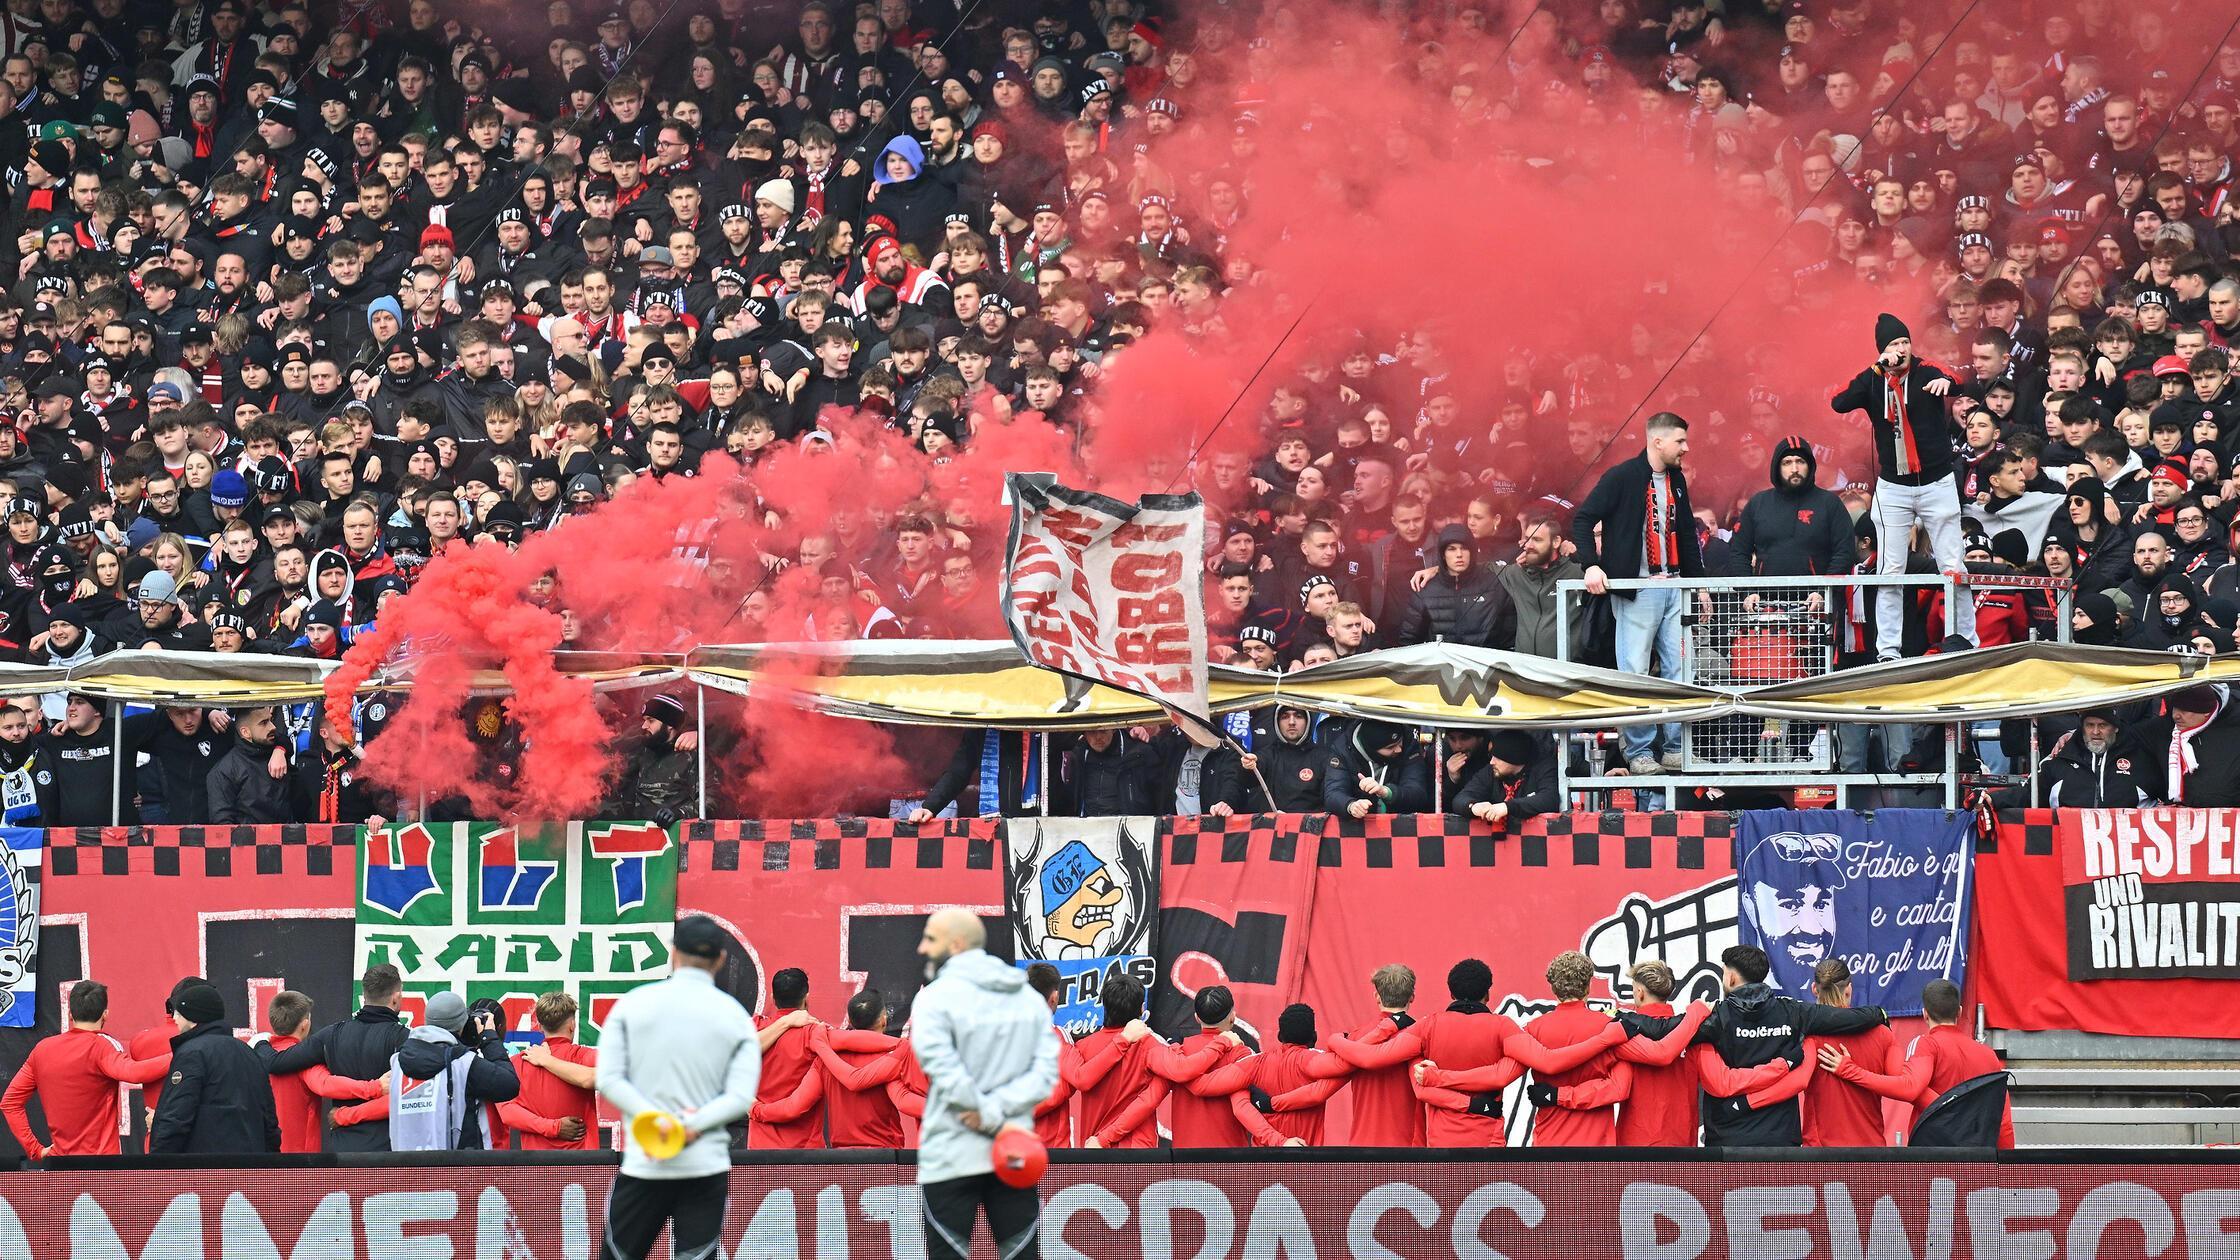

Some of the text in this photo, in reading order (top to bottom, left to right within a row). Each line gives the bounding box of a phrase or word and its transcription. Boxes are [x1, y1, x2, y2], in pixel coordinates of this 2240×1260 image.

[1845, 840, 1919, 879] Fabio
[1923, 847, 1939, 876] è
[2081, 808, 2240, 877] RESPE
[2092, 873, 2144, 909] UND
[1871, 906, 1886, 927] e
[364, 932, 670, 974] RAPID
[1878, 938, 1914, 987] gli
[1063, 1011, 1099, 1035] seit
